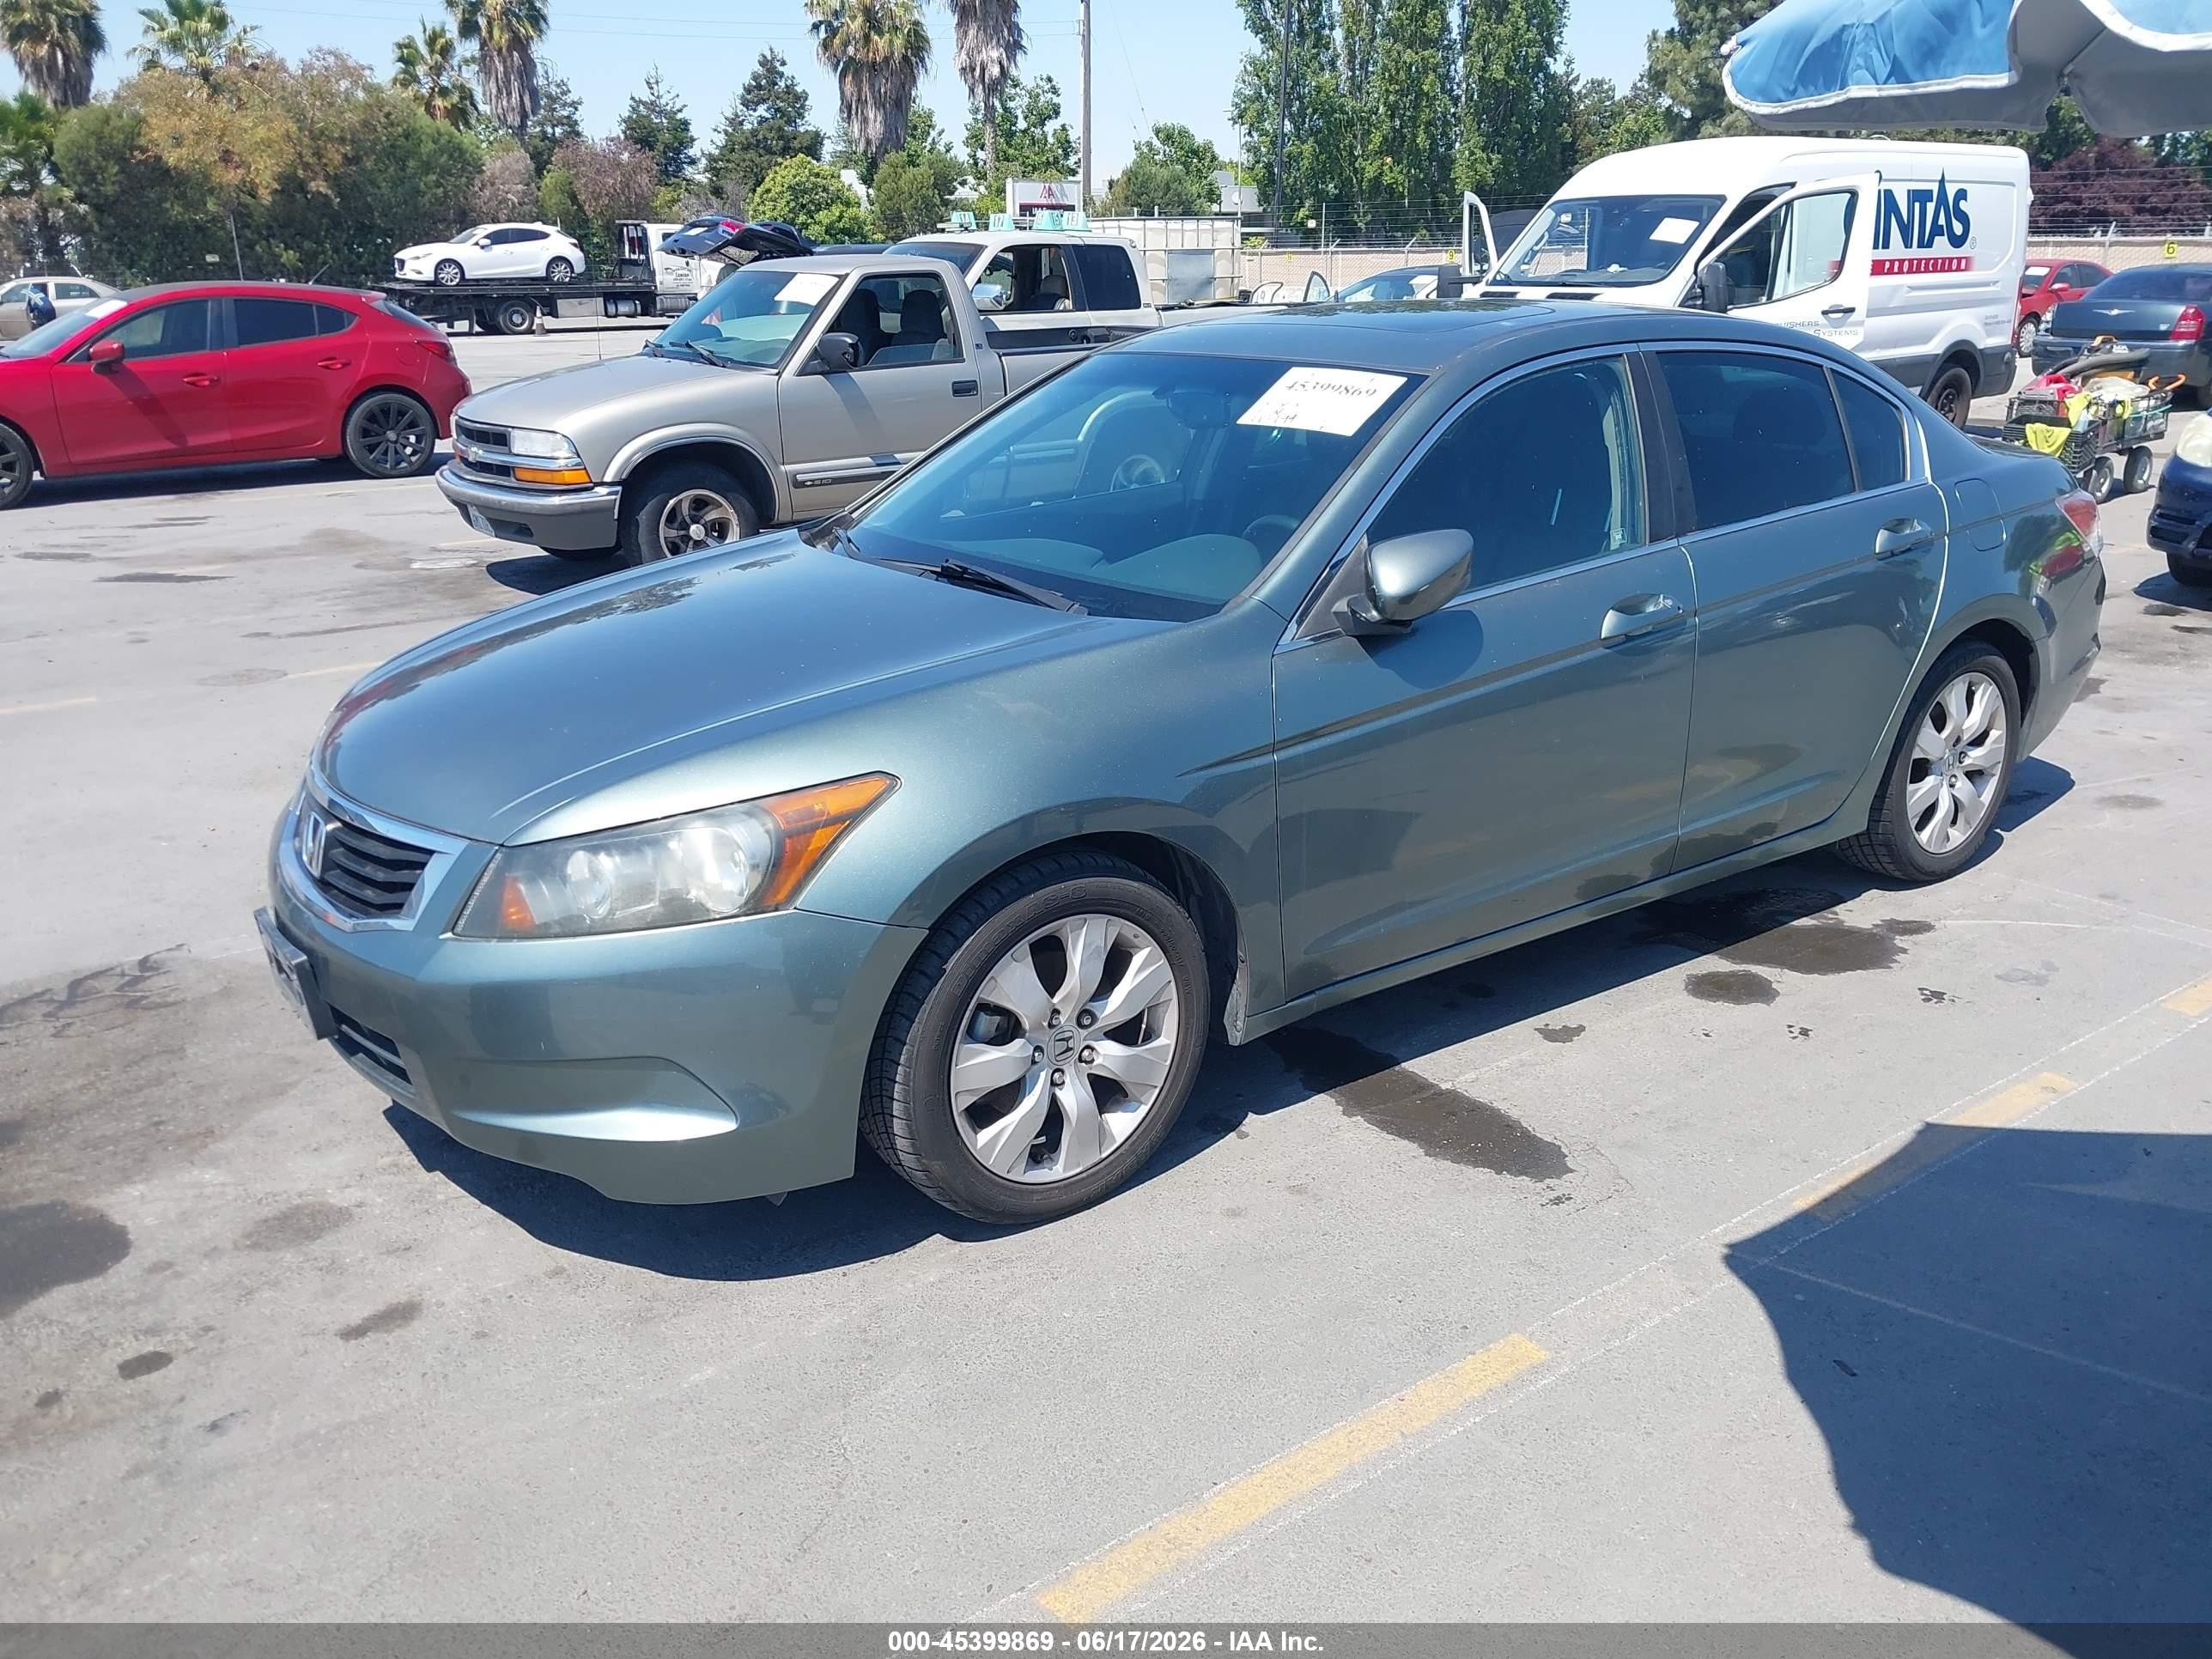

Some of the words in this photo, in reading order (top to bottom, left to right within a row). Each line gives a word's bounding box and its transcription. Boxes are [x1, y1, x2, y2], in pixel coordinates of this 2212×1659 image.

[2166, 241, 2176, 255] 6
[1449, 251, 1454, 260] 9
[1884, 259, 1966, 274] PROTECTION
